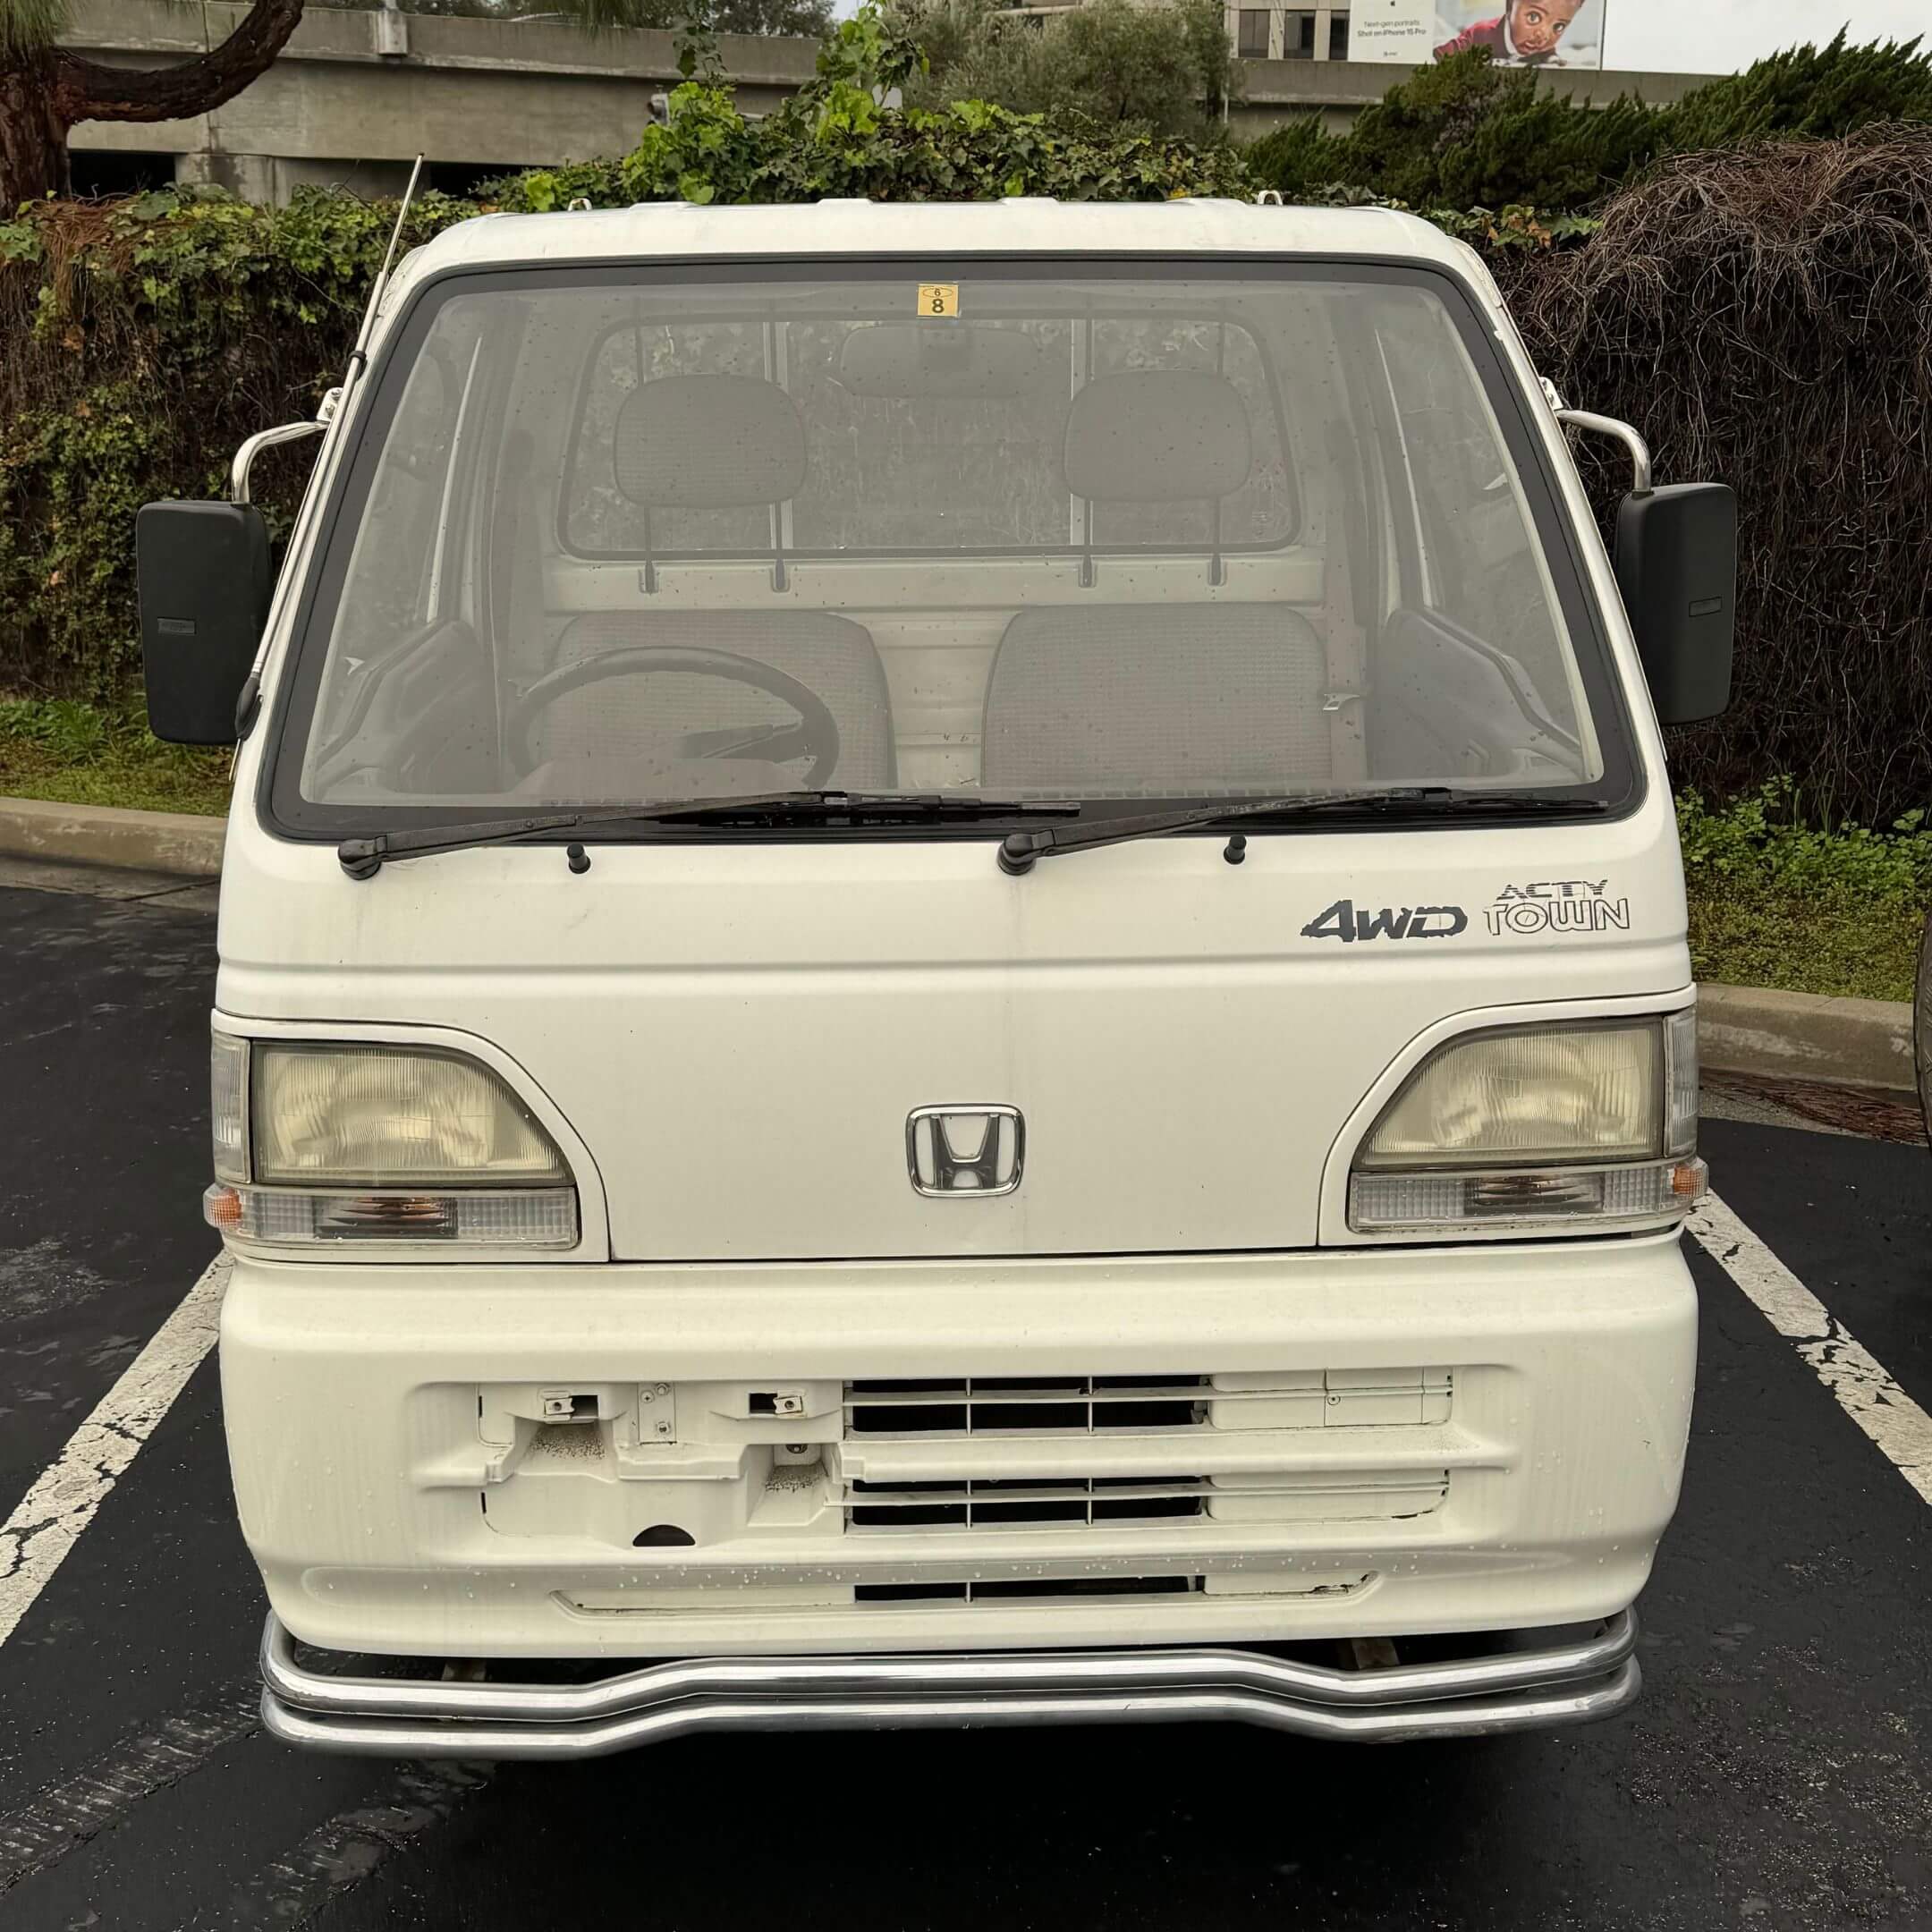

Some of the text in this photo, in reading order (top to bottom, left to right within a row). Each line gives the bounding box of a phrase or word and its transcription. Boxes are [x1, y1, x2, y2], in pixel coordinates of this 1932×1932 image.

[934, 287, 941, 297] 6
[932, 299, 945, 314] 8
[1496, 879, 1608, 901] ACTY
[1300, 899, 1469, 942] 4WD
[1482, 897, 1631, 936] TOWN
